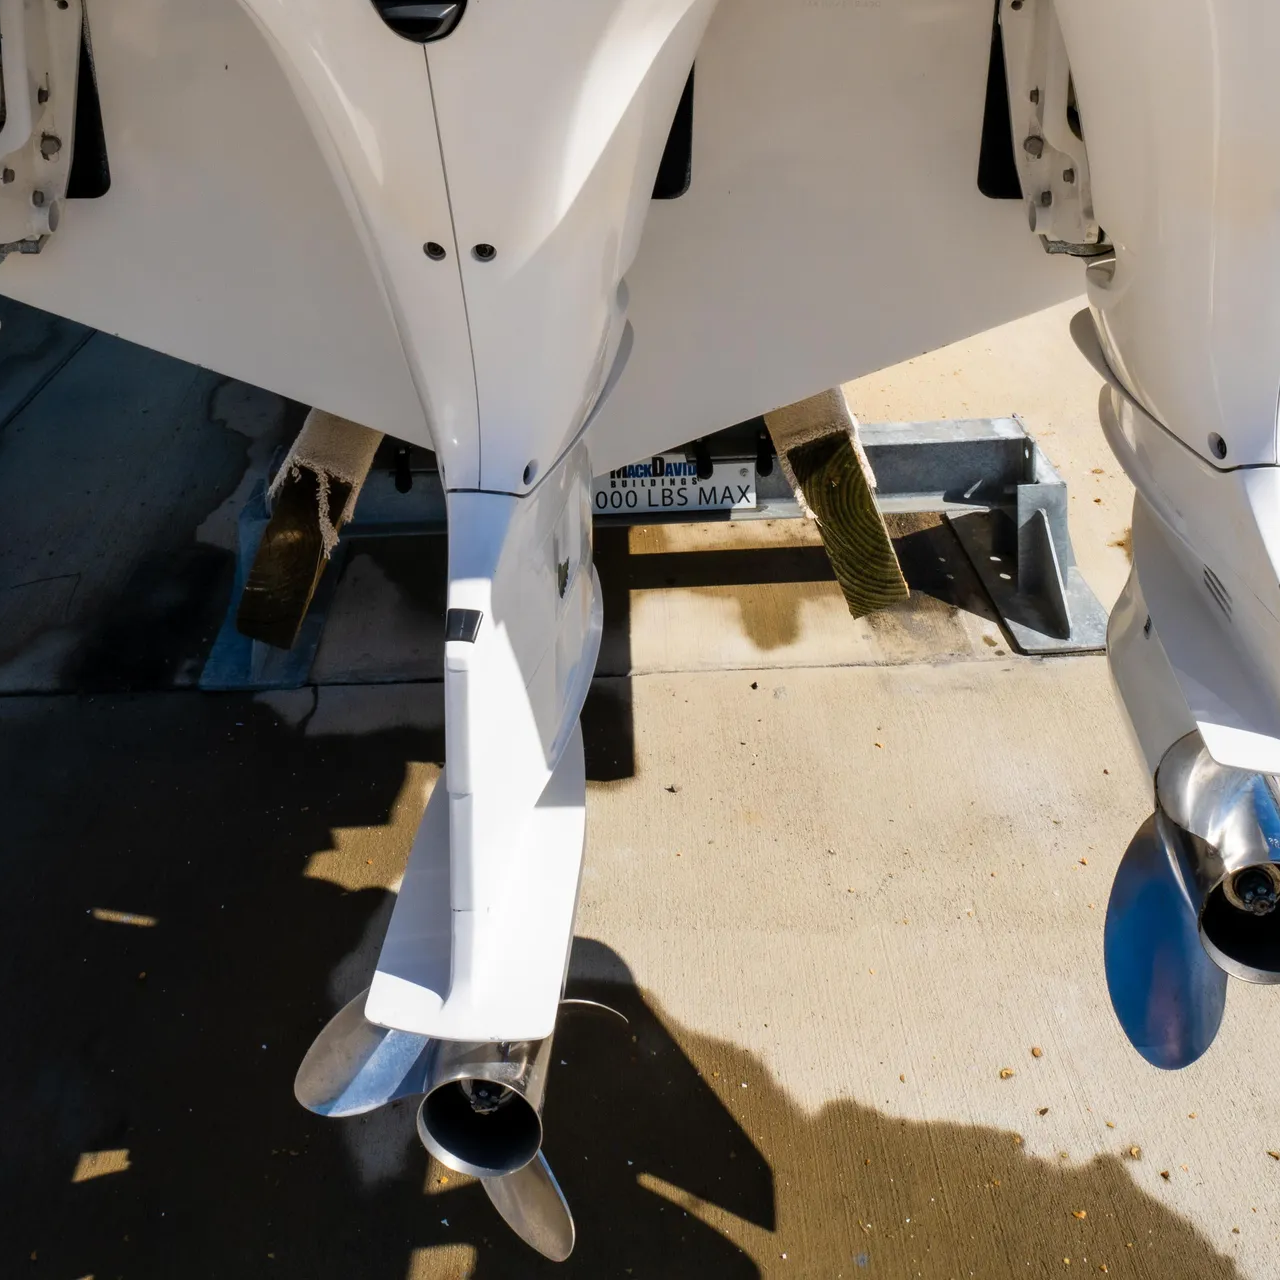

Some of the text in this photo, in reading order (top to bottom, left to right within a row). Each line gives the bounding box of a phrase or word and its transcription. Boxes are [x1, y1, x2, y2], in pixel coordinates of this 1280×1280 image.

[610, 477, 697, 489] BUILDINGS
[648, 487, 689, 507] LBS
[698, 485, 751, 505] MAX
